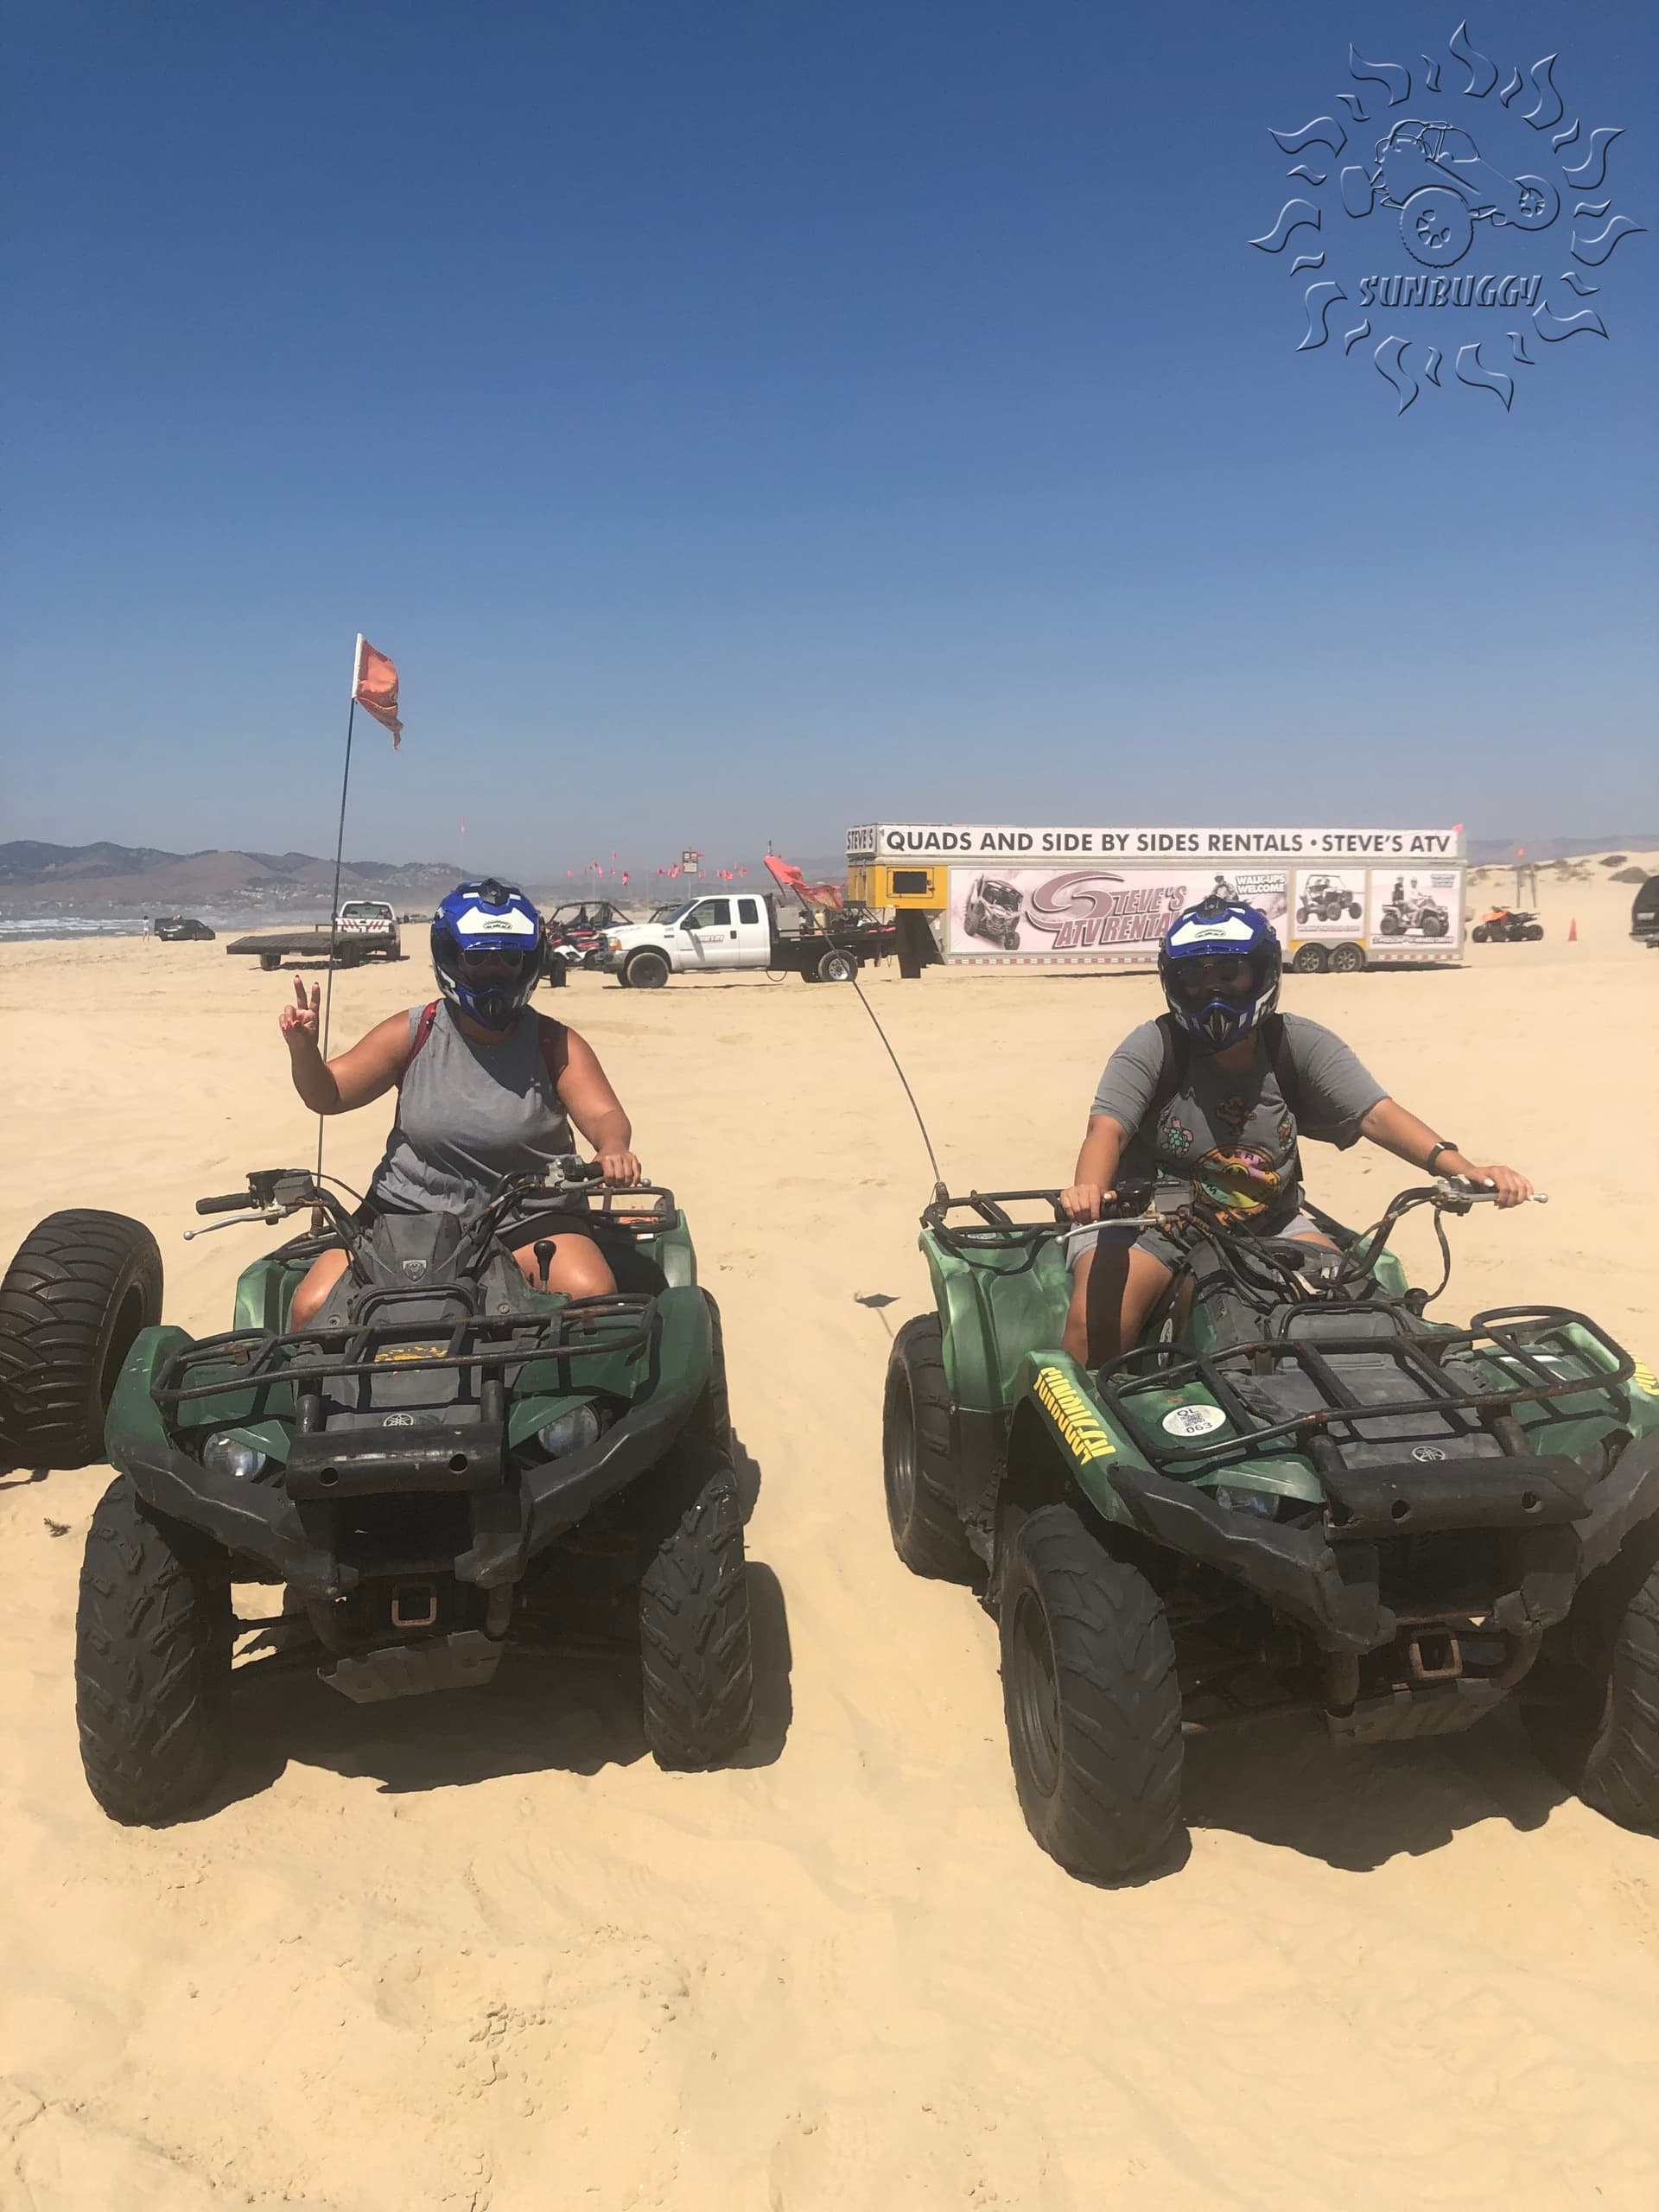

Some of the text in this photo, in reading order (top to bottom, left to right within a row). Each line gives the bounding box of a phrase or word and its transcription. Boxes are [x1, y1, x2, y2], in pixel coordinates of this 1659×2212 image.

[847, 829, 874, 850] STEVE'S
[886, 830, 1451, 853] QUADS AND SIDE BY SIDES RENTALS STEVE'S ATV
[1236, 883, 1286, 895] WELCOME
[1052, 916, 1106, 949] ATV
[1185, 1421, 1213, 1433] 063
